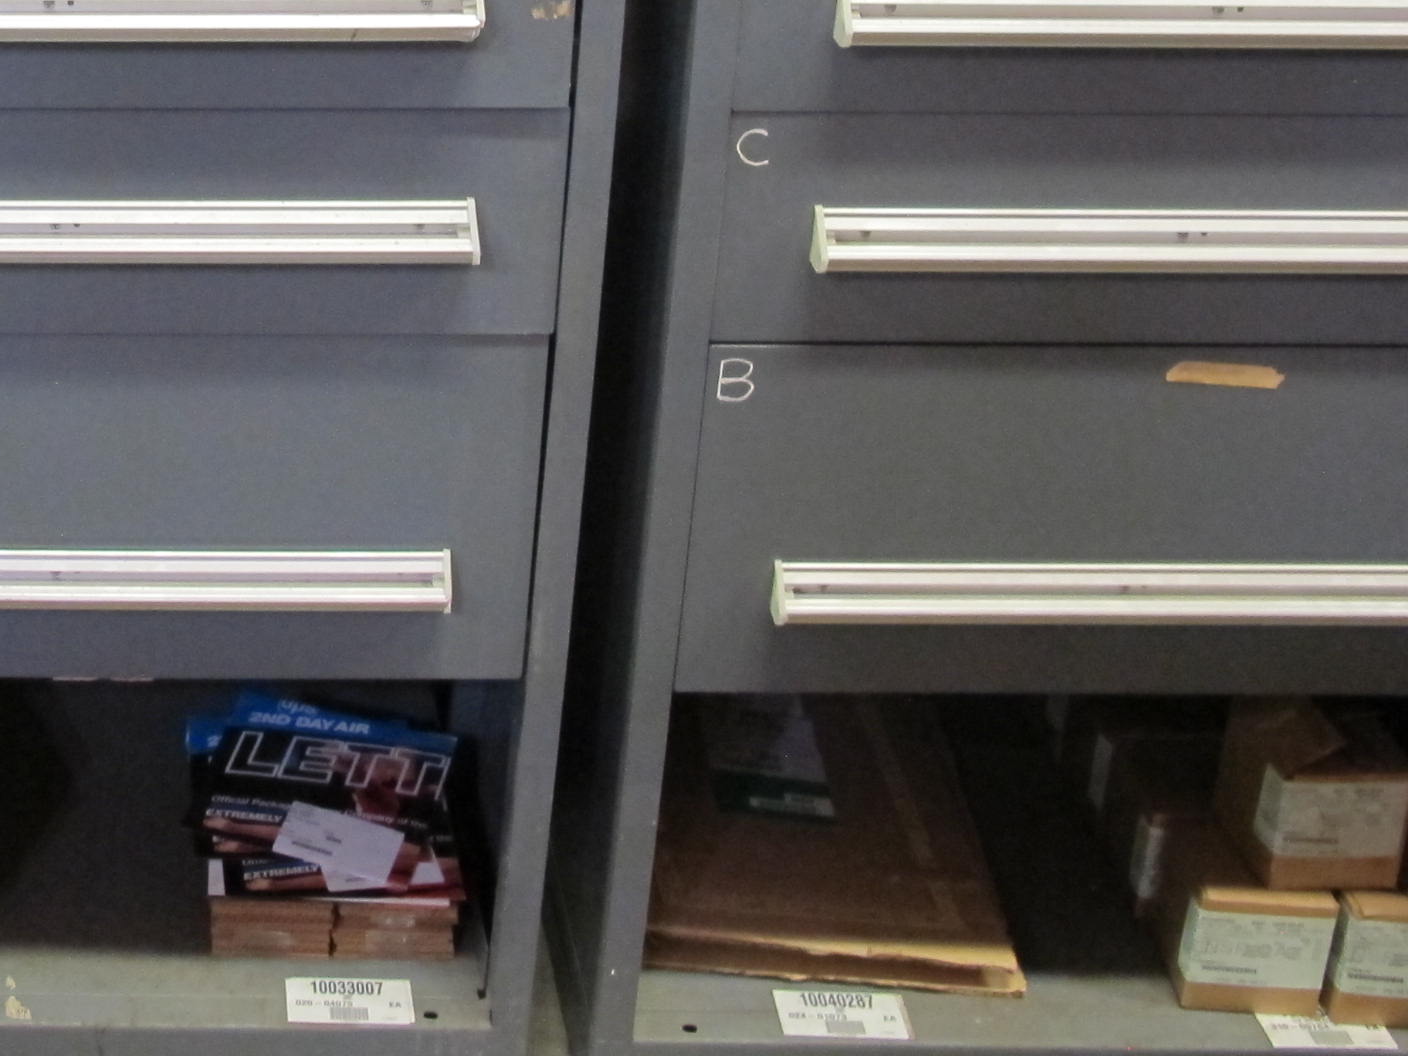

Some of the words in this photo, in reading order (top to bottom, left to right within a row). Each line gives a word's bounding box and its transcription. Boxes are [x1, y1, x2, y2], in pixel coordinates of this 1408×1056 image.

[736, 128, 770, 167] C
[716, 357, 755, 402] B
[248, 711, 292, 726] 2ND
[294, 715, 335, 731] DAY
[333, 721, 371, 735] AIR
[224, 730, 451, 801] LETT
[310, 979, 384, 996] 10033007
[799, 992, 874, 1009] 10040287
